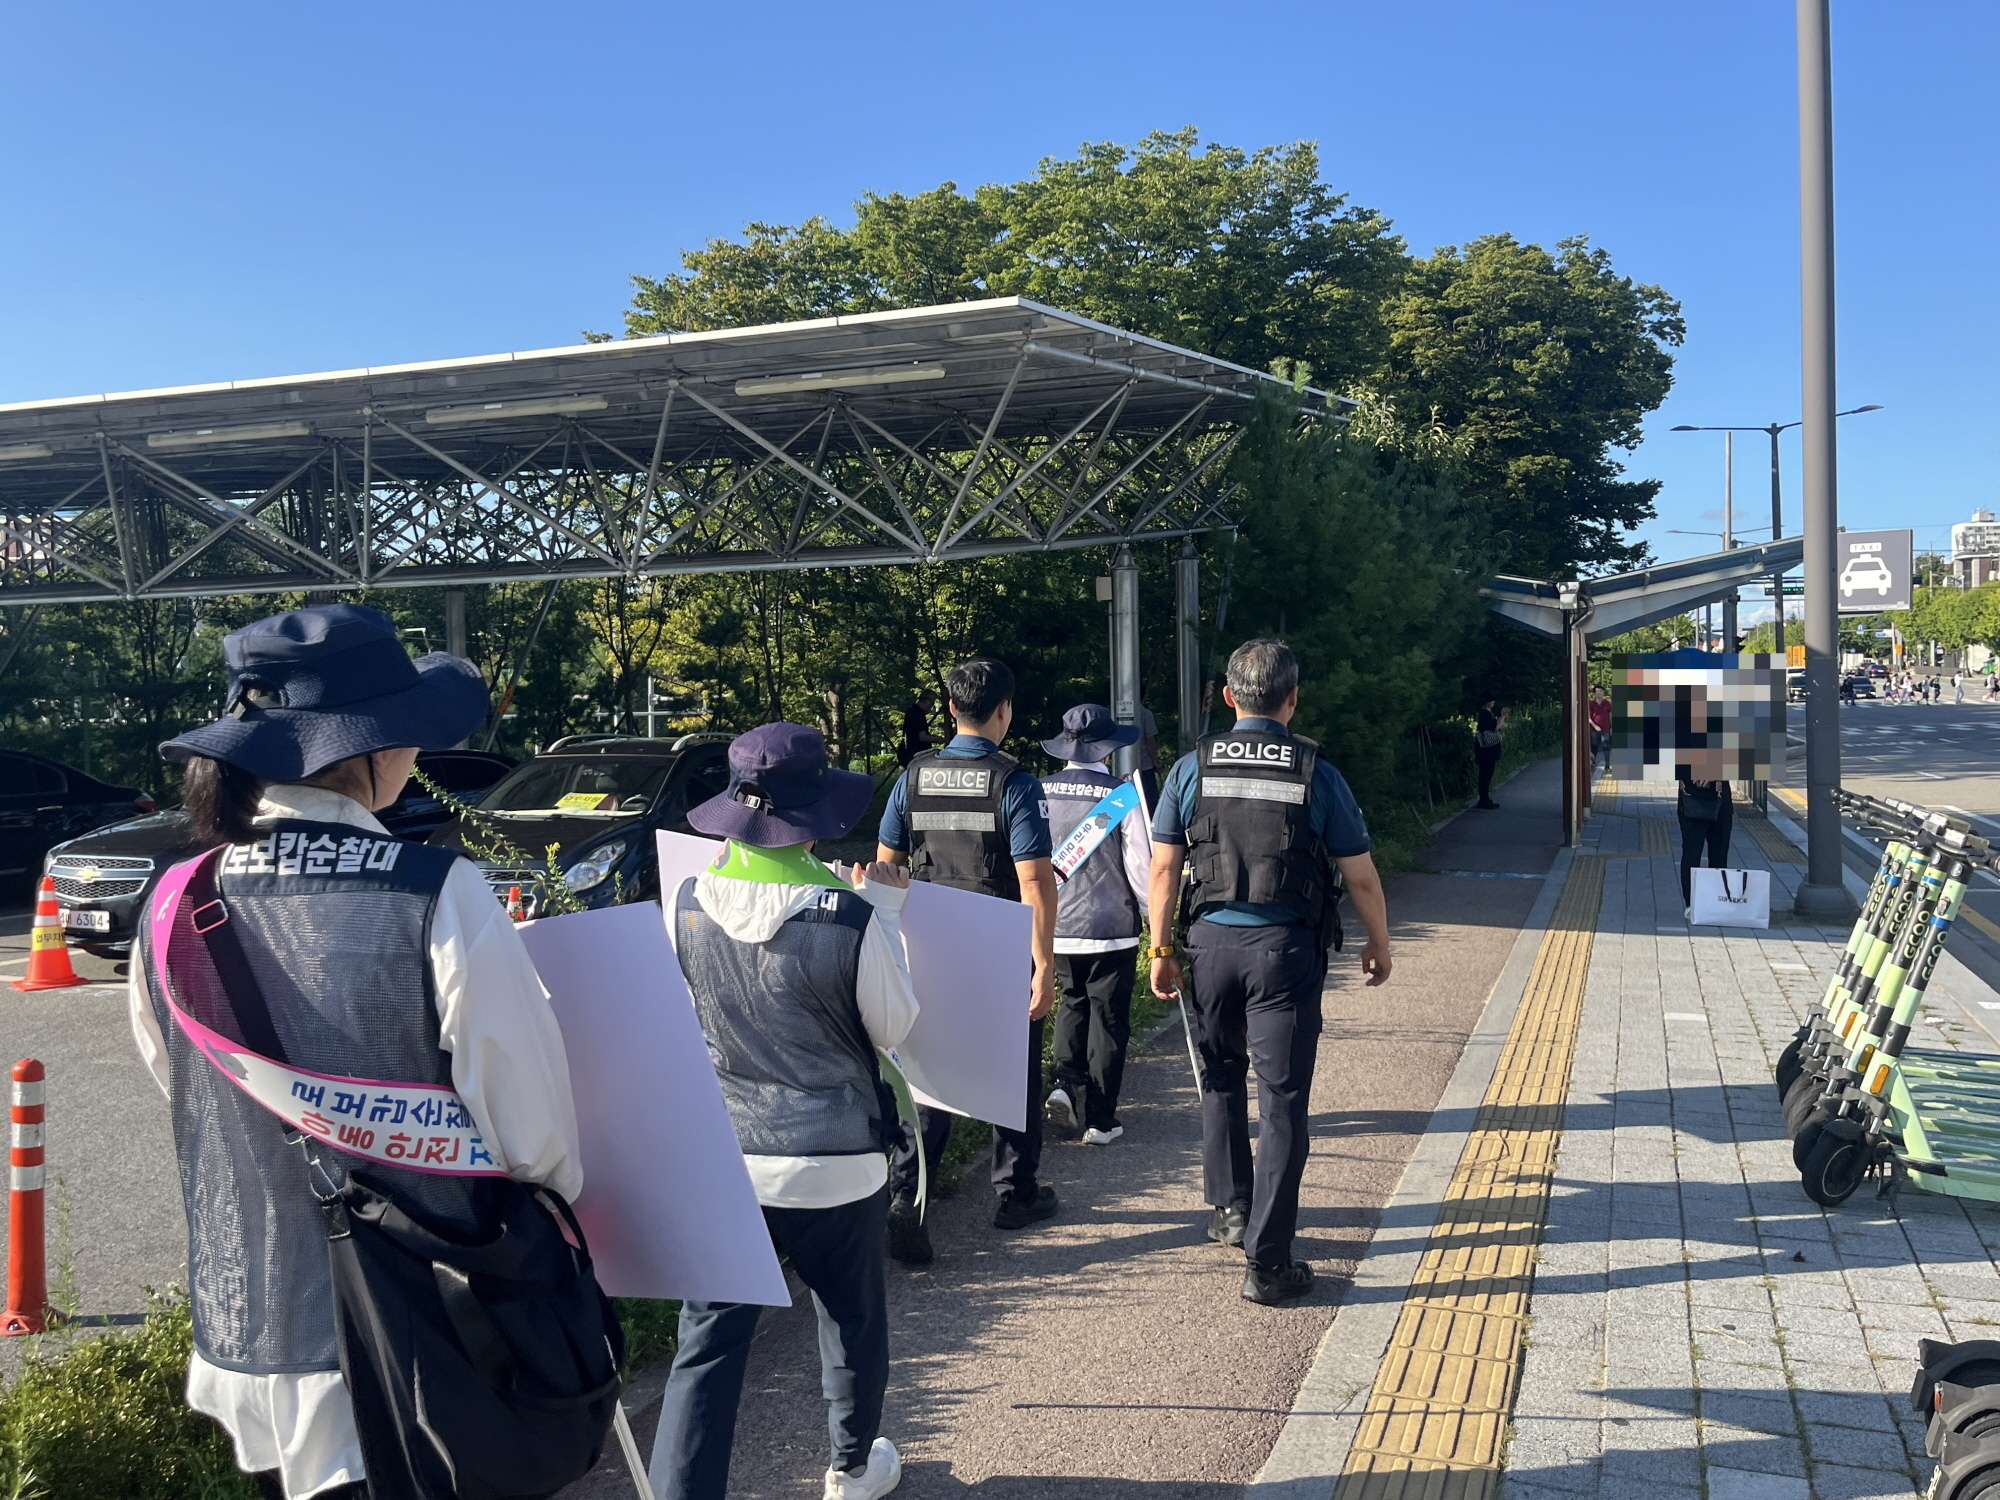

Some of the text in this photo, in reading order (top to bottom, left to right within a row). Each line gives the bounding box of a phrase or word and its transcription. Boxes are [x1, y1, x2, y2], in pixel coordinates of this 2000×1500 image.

[1211, 741, 1292, 761] POLICE
[921, 770, 986, 788] POLICE
[221, 832, 404, 876] 로보캅순찰대
[76, 912, 104, 927] 6304
[1889, 890, 1914, 935] GCOO
[1904, 910, 1930, 959] GCOO
[300, 1109, 376, 1150] 아동
[384, 1131, 461, 1165] 안전
